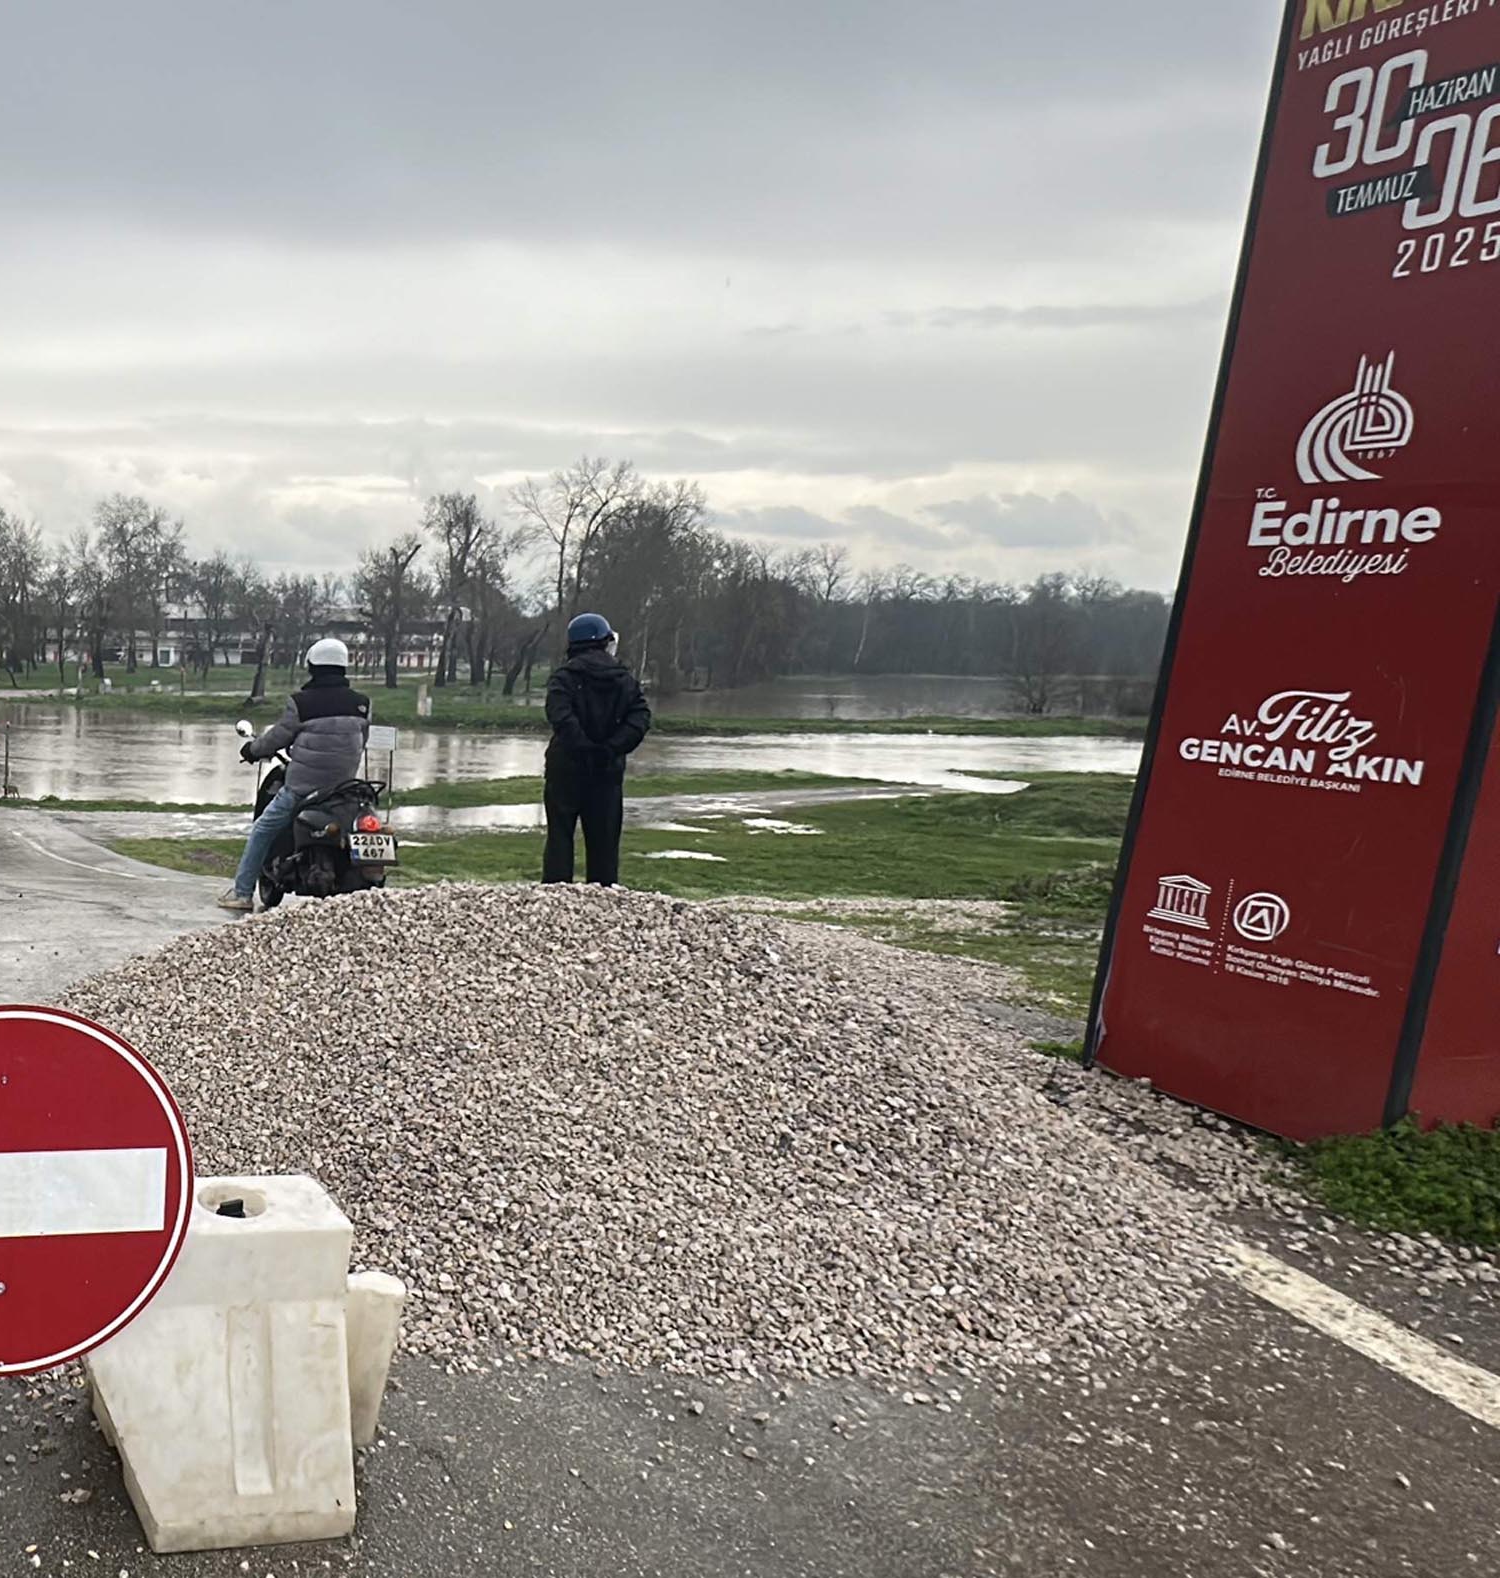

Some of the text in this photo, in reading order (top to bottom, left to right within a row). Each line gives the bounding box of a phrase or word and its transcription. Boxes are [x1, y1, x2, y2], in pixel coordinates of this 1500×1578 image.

[1298, 35, 1352, 71] YAĞLI
[1313, 49, 1428, 178] 30
[1408, 68, 1497, 116] HAZİRAN
[1336, 171, 1417, 214] TEMMUZ
[1392, 222, 1500, 279] 2025
[1247, 497, 1442, 547] Edirne
[1258, 545, 1410, 583] Belediyesi
[1220, 690, 1377, 761] Av. Filiz
[1179, 737, 1424, 786] GENCAN AKIN
[1310, 778, 1361, 793] BAŞKANI
